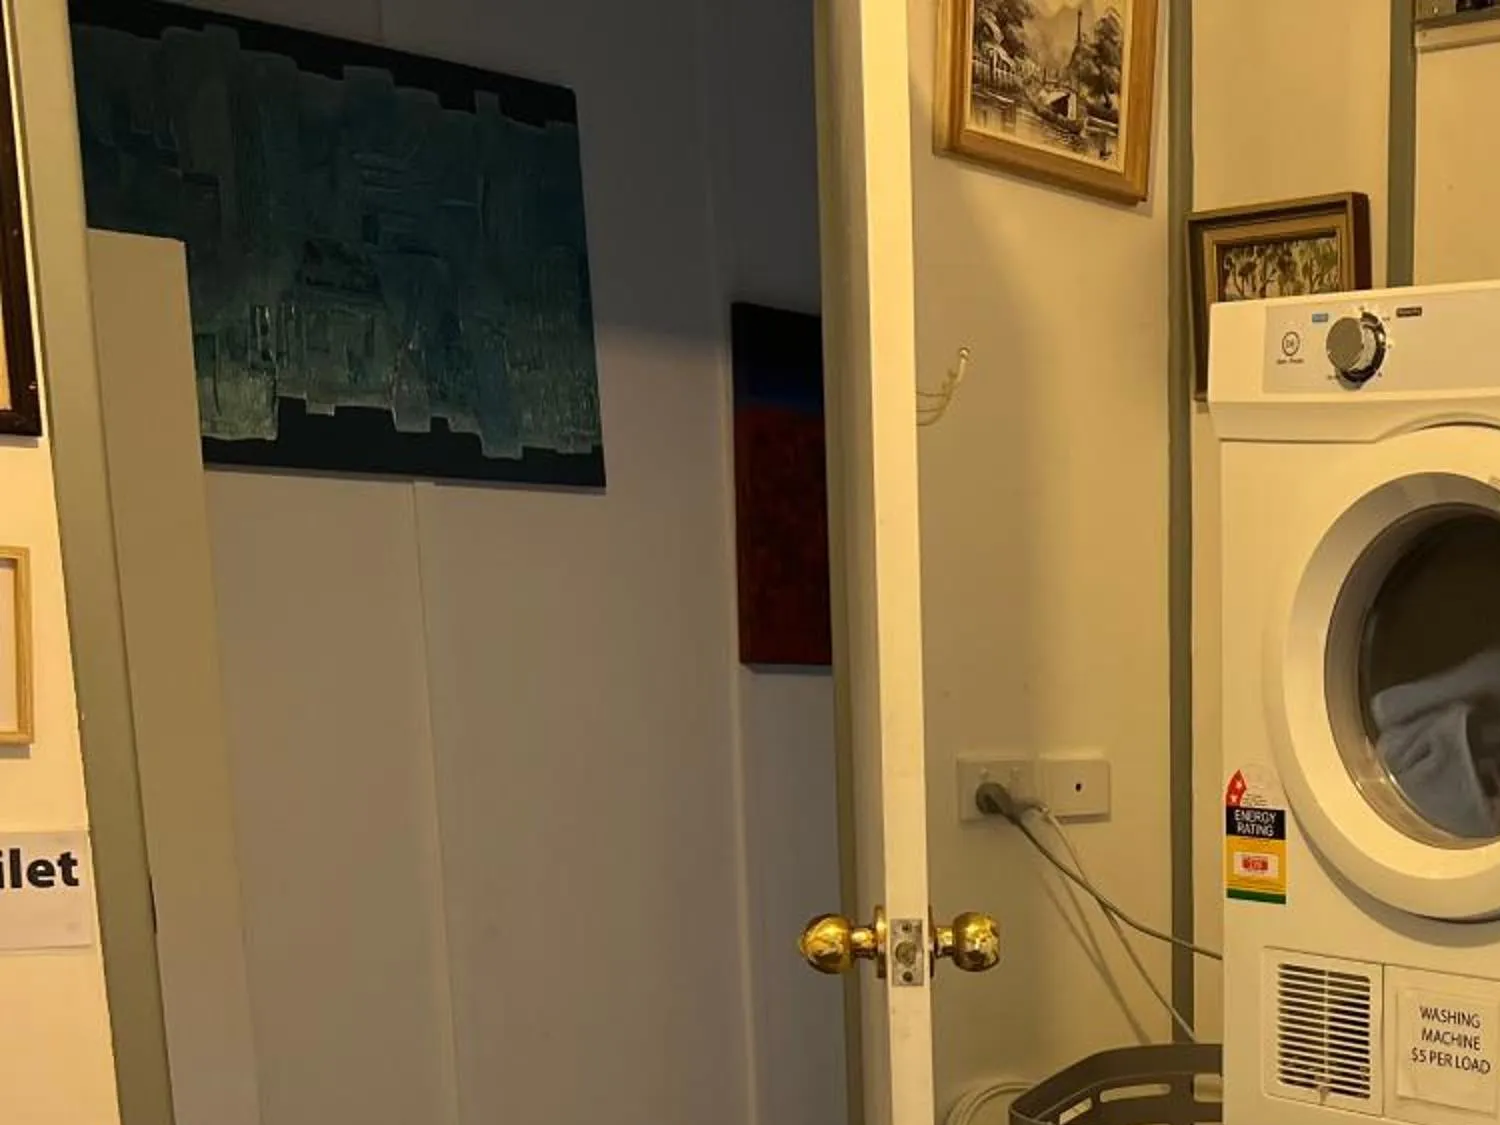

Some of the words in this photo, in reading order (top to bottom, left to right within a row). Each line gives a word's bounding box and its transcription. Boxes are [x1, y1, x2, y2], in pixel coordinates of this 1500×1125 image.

[1234, 809, 1277, 825] ENERGY
[1236, 823, 1275, 837] RATING
[1419, 1005, 1482, 1029] WASHING
[1420, 1027, 1481, 1051] MACHINE
[1411, 1046, 1427, 1063] $5
[1429, 1049, 1453, 1068] PER
[1455, 1055, 1491, 1075] LOAD
